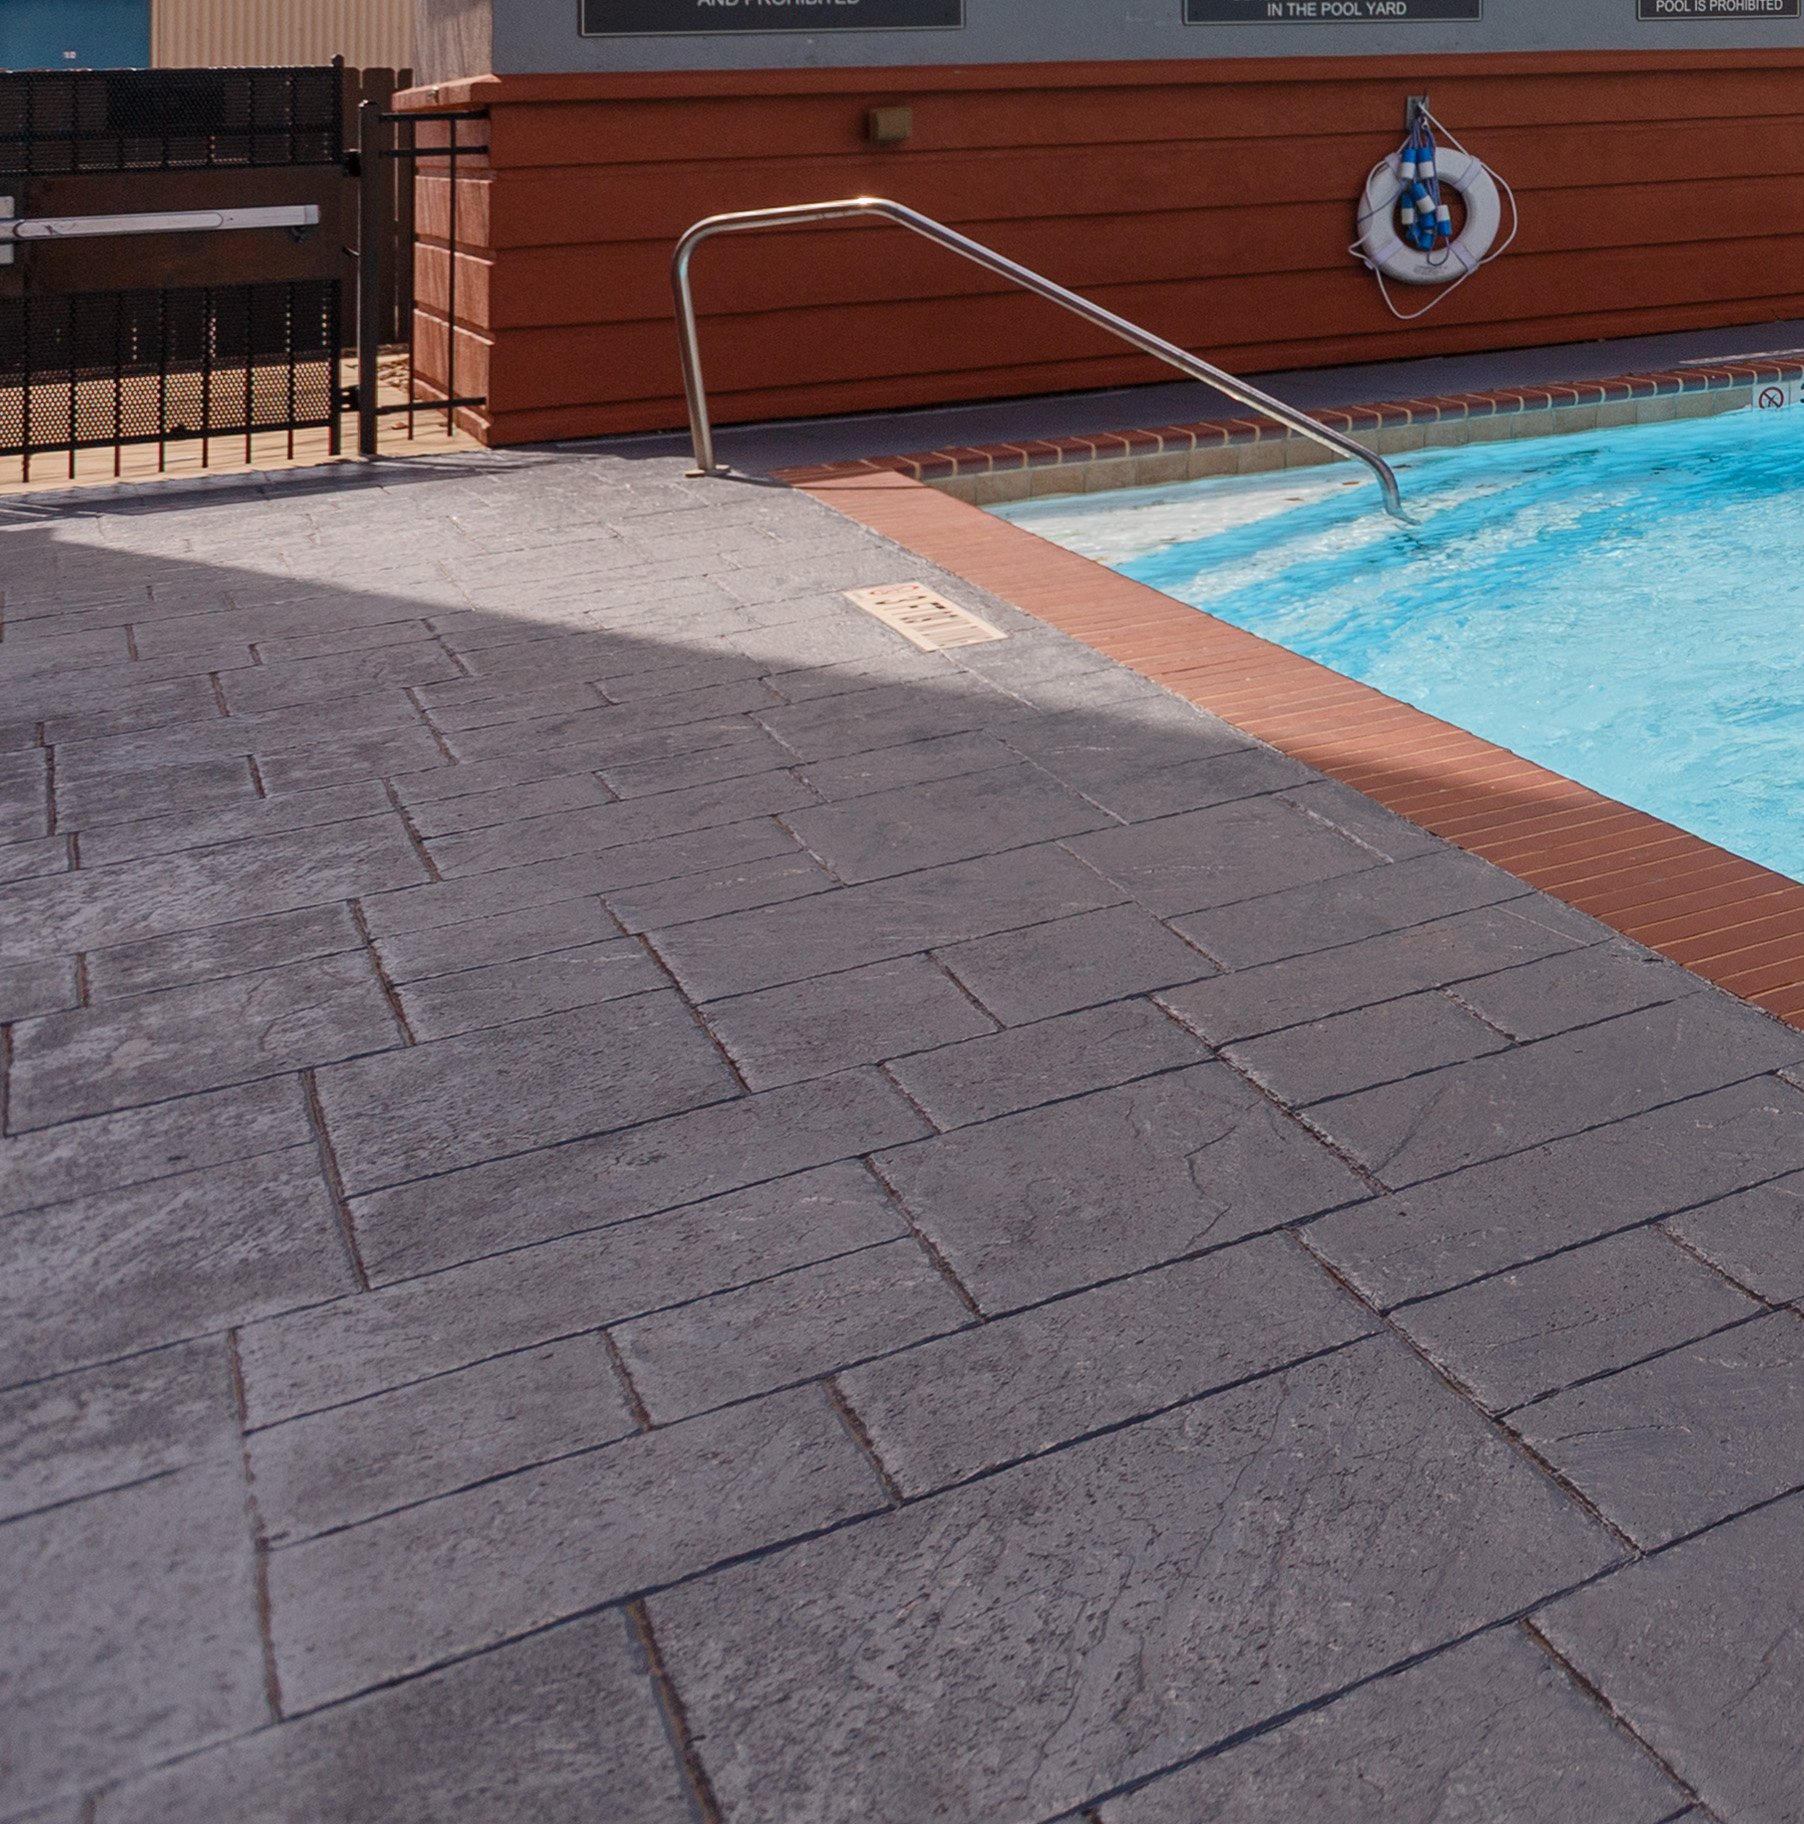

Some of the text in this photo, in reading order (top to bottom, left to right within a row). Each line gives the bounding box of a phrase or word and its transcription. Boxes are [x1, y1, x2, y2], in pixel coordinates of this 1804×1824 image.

[1268, 2, 1406, 16] IN THE POOL YARD
[1656, 0, 1783, 12] POOL IS PROHIBITED
